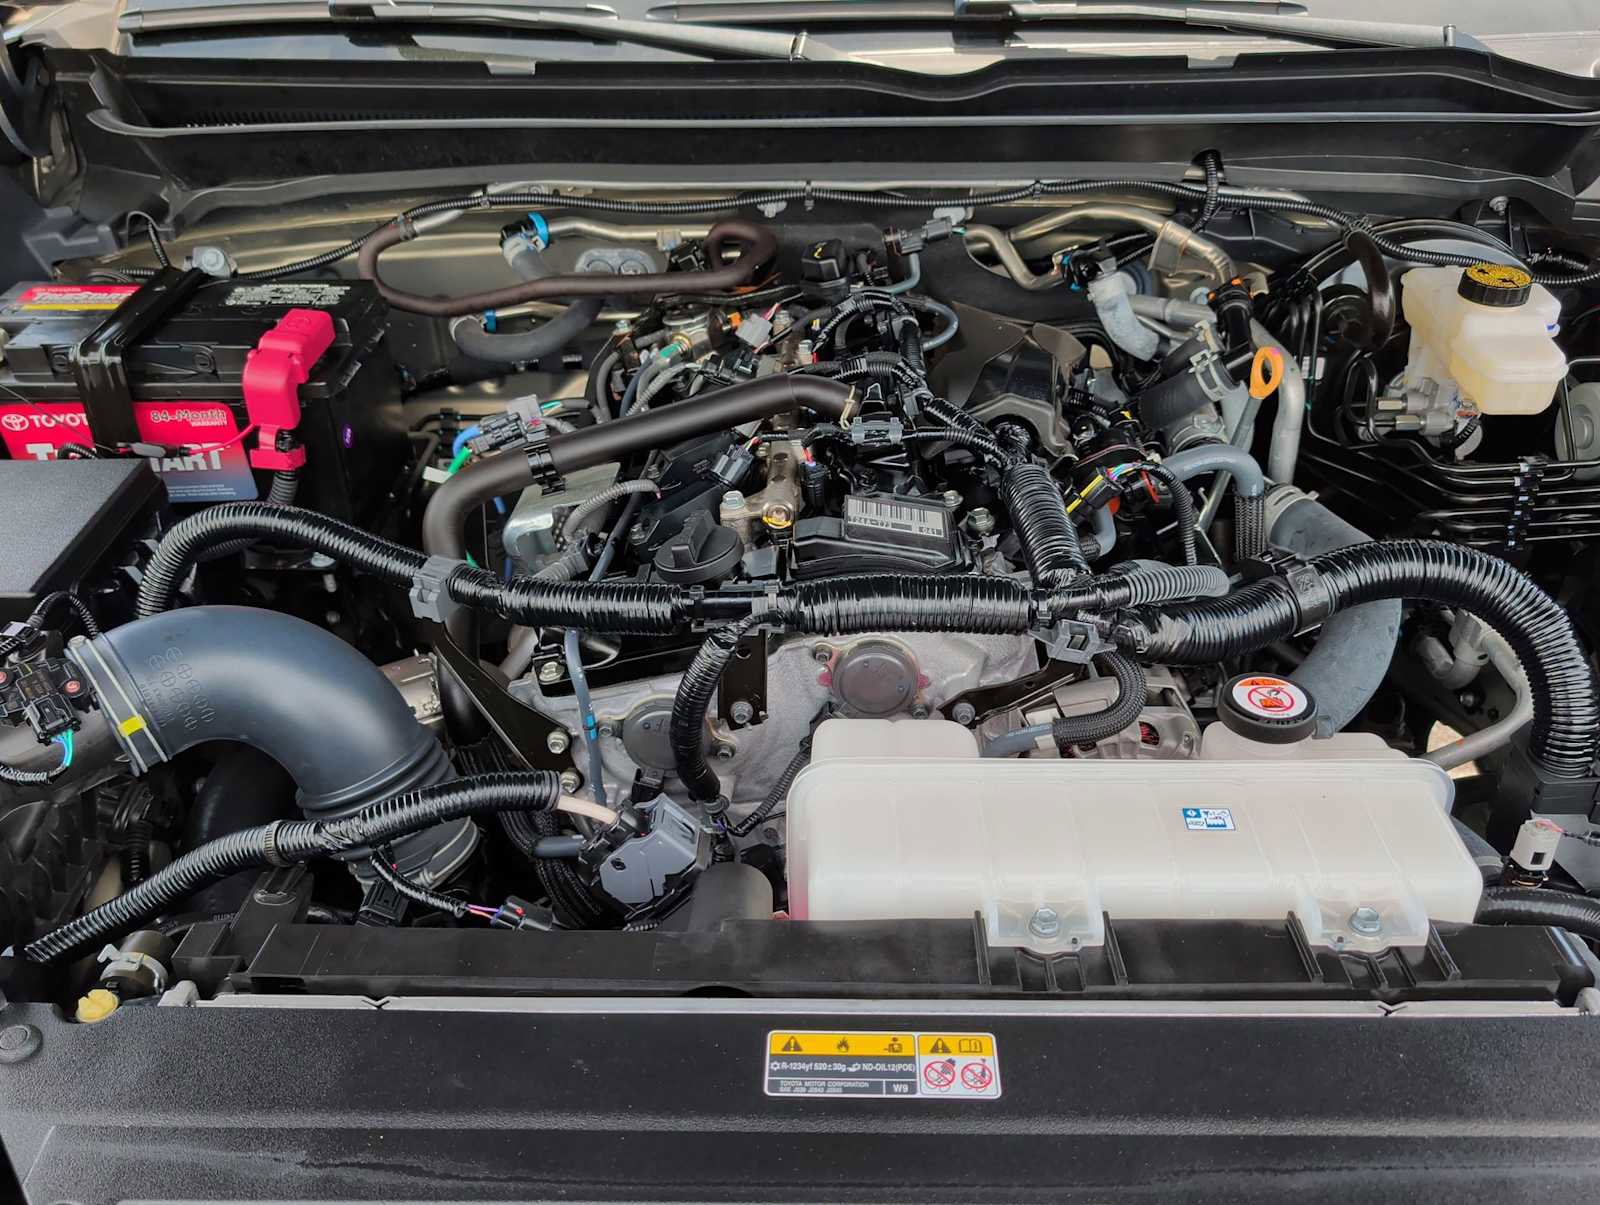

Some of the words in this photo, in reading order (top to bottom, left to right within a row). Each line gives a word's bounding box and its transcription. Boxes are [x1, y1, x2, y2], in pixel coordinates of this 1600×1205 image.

[29, 412, 89, 428] TOYOT
[150, 409, 227, 423] 84-Month
[781, 1061, 813, 1072] R-1234yf
[892, 1083, 909, 1093] W9
